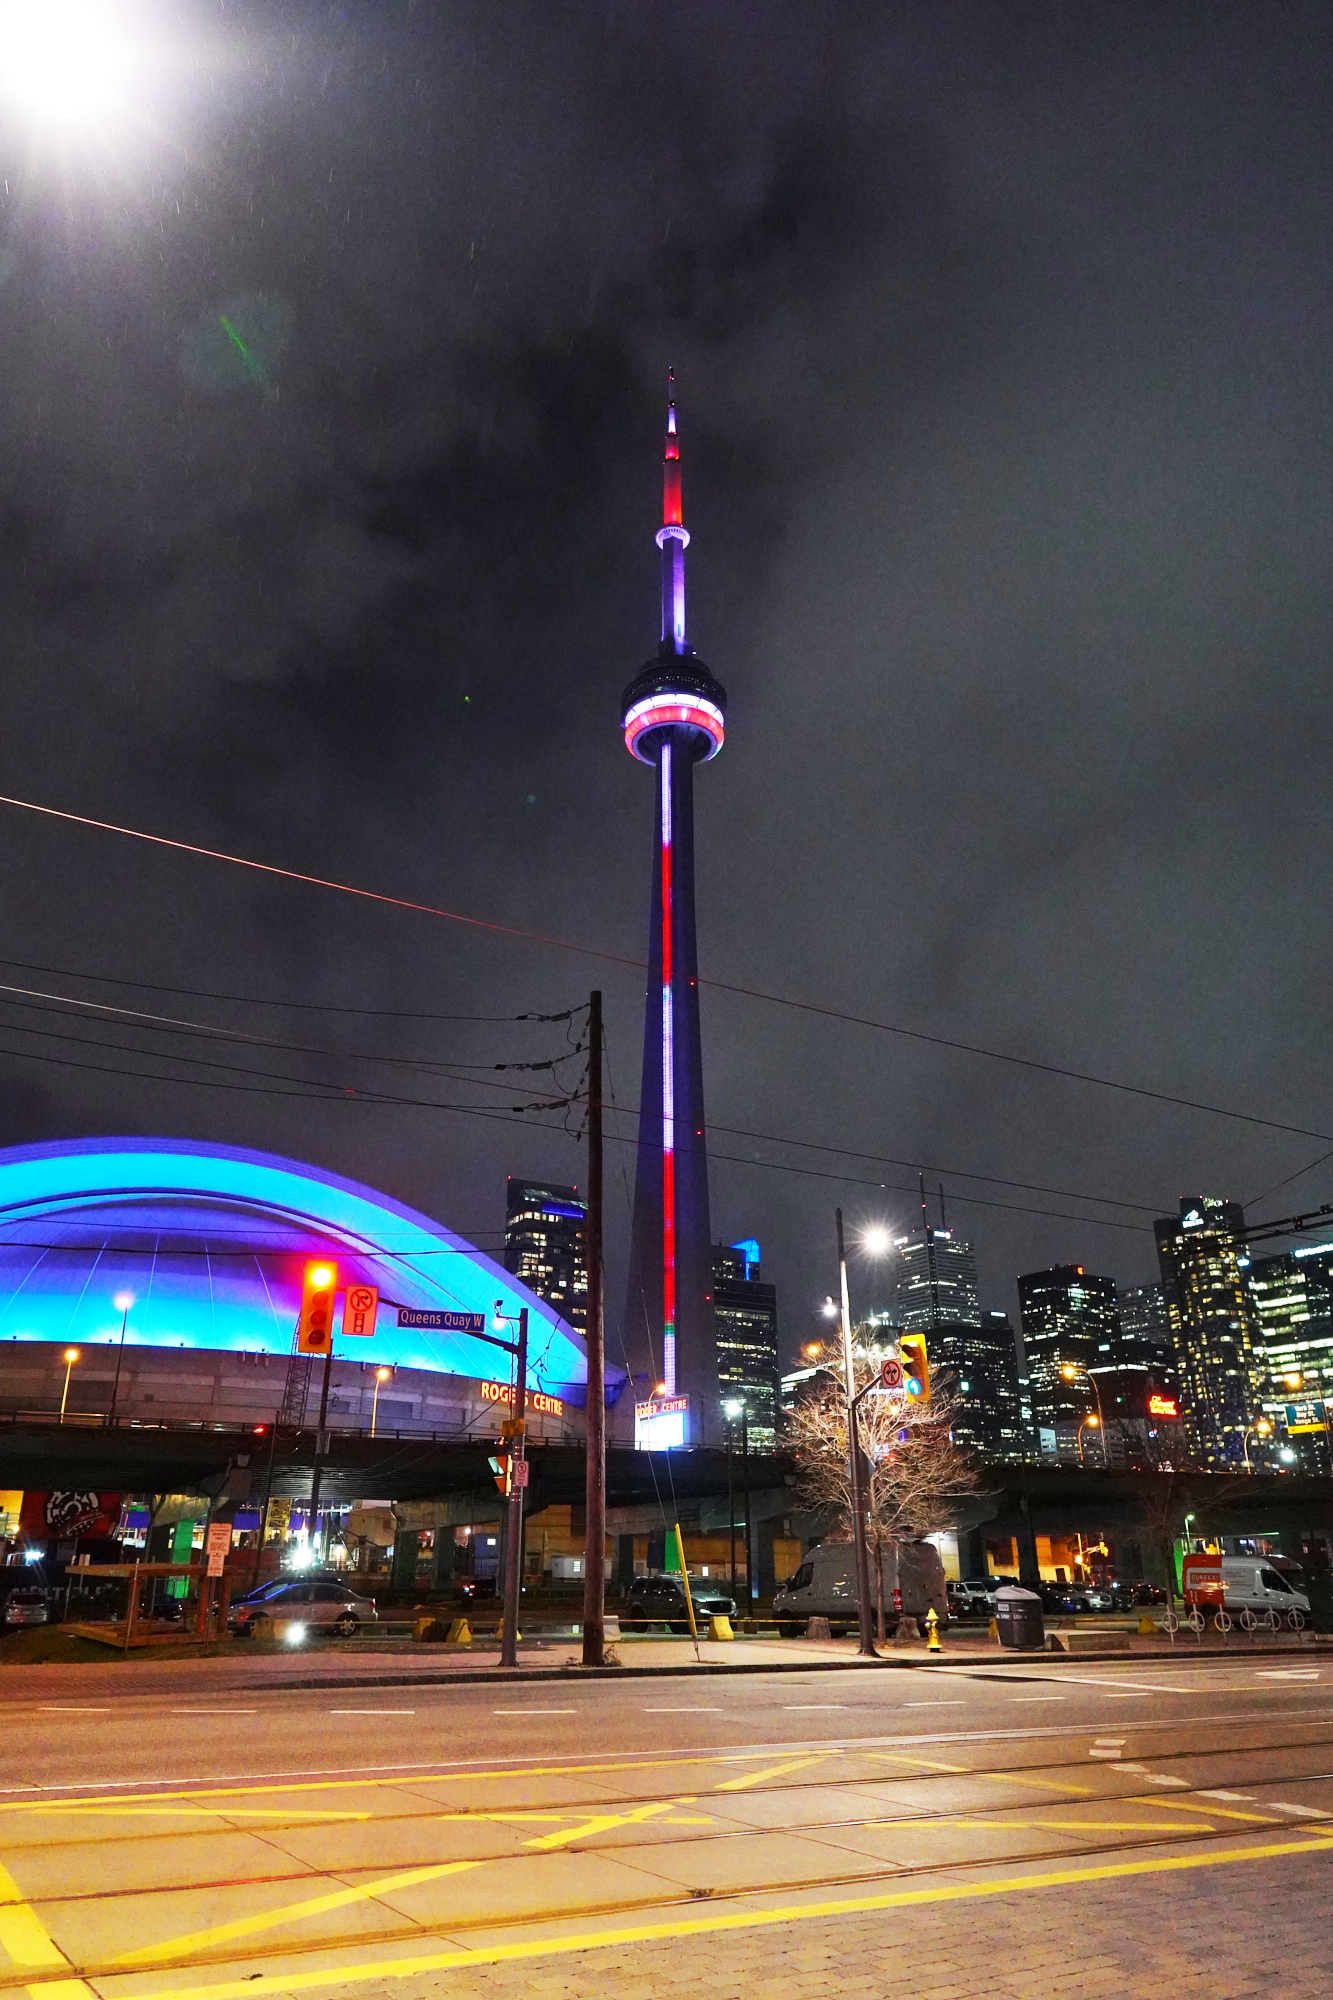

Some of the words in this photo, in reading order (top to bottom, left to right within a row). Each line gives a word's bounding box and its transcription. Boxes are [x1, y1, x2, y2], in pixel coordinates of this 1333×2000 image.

[401, 1310, 441, 1325] Queens
[445, 1313, 471, 1329] Quay
[473, 1314, 482, 1327] W
[533, 1393, 563, 1417] CENTRE
[662, 1399, 686, 1412] CENTRE
